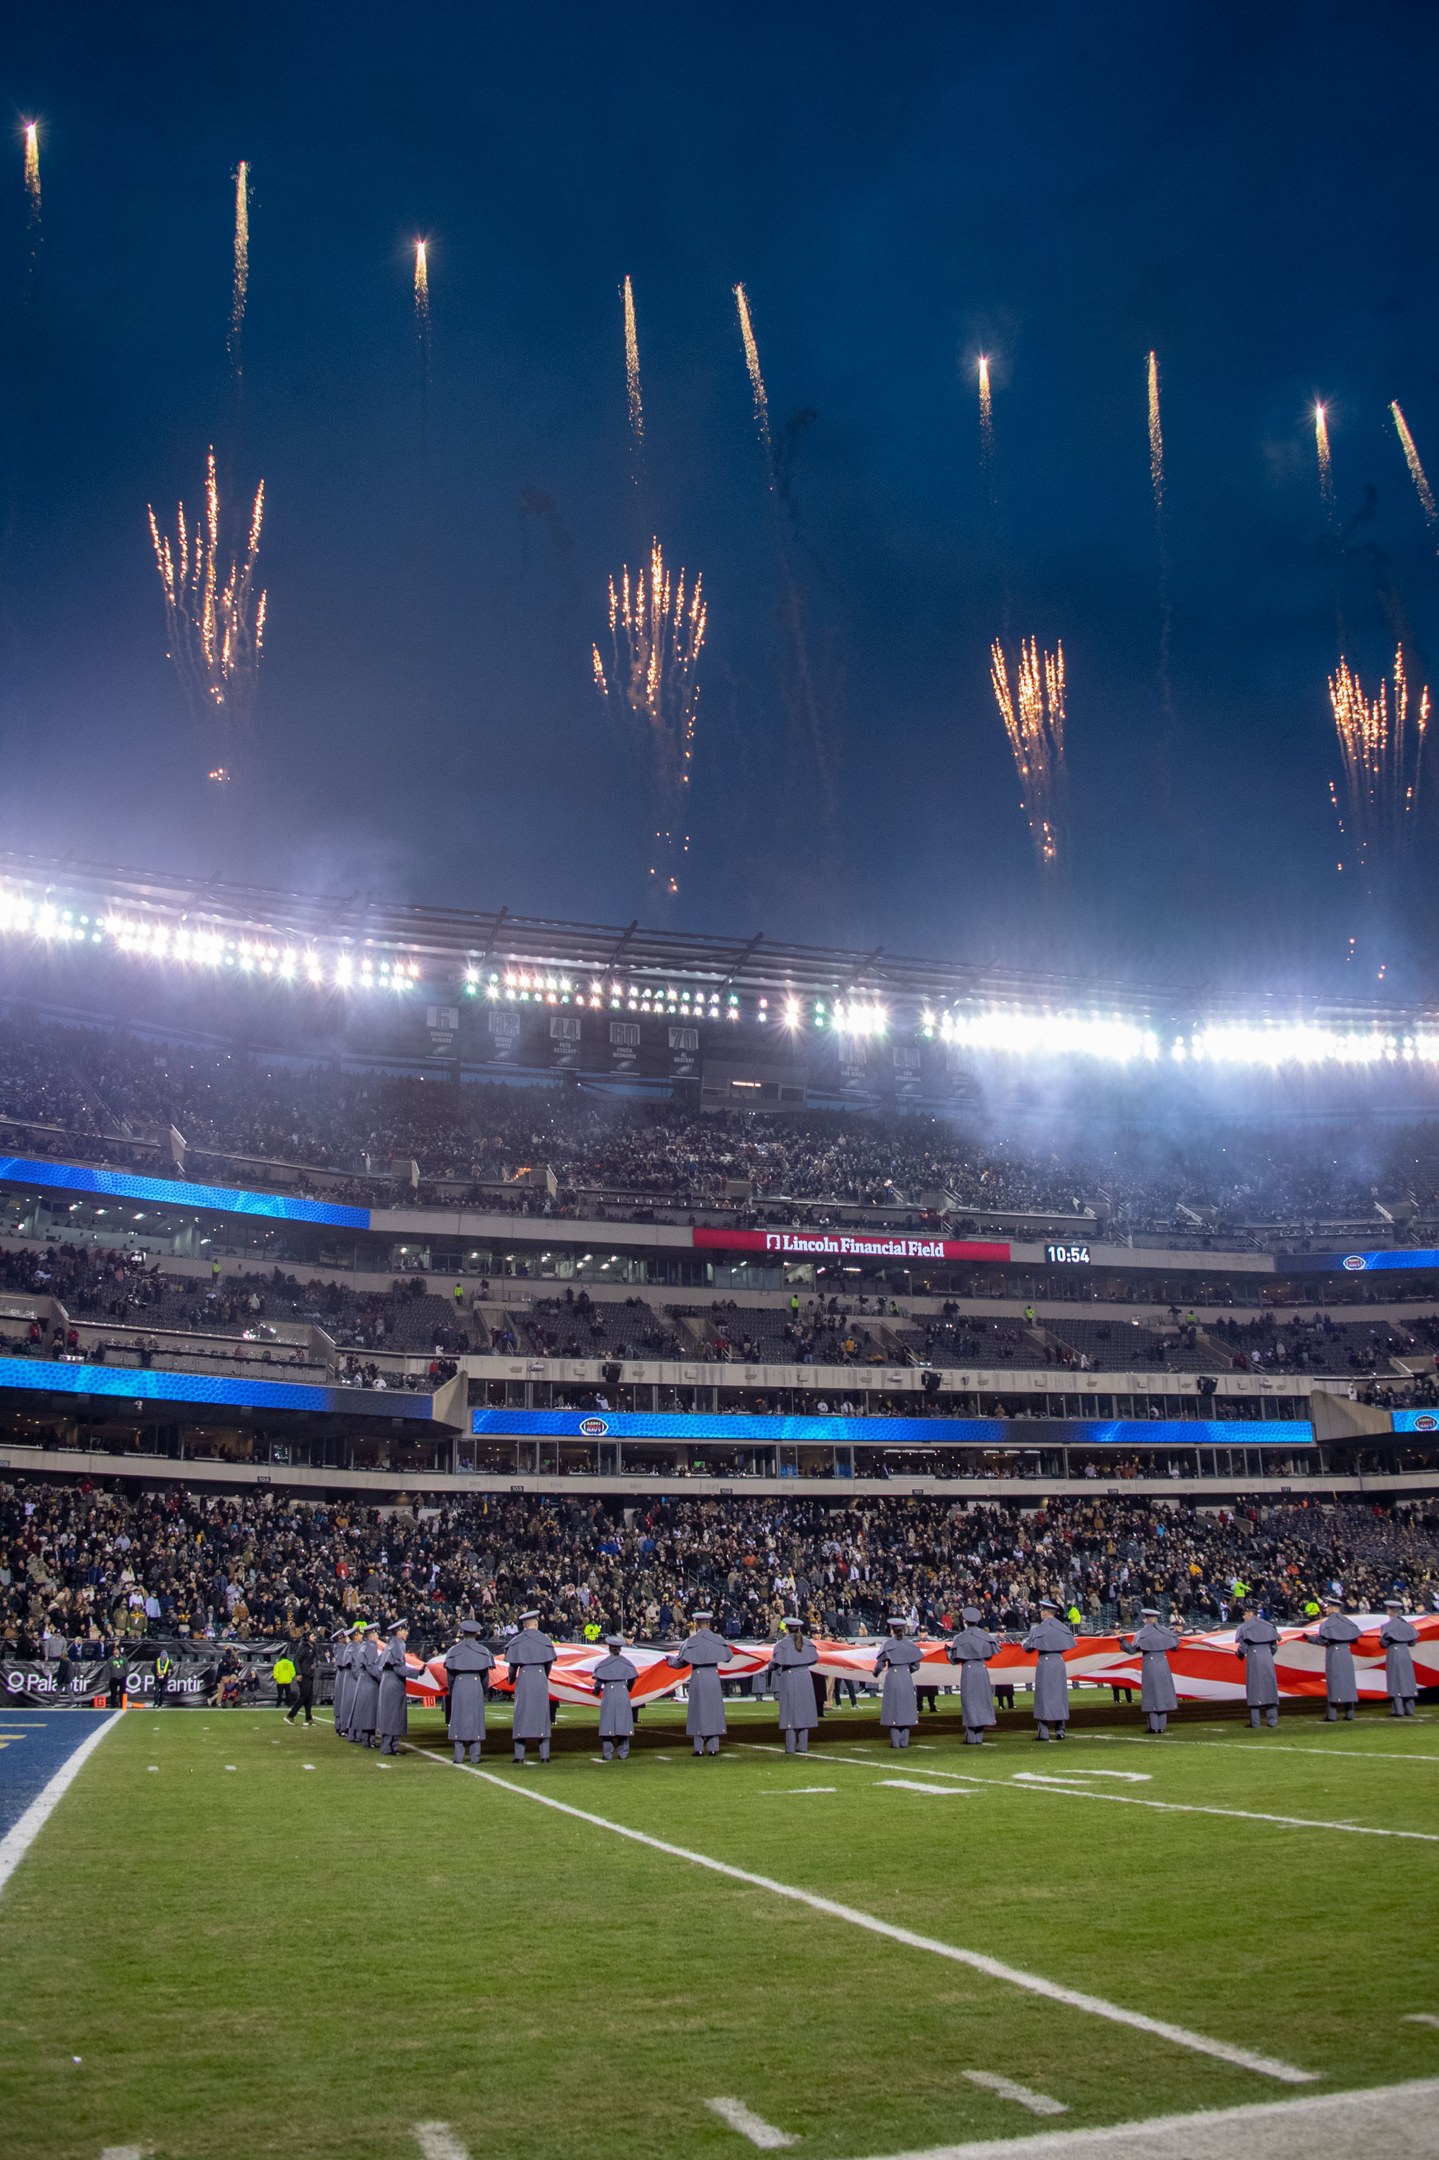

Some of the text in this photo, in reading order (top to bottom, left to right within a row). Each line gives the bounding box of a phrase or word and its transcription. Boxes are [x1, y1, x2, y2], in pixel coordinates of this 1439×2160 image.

[552, 1019, 577, 1041] 44
[612, 1024, 637, 1048] 60
[671, 1028, 696, 1051] 70
[782, 1235, 945, 1258] Lincoln Financial Field
[1048, 1246, 1090, 1263] 10:54
[27, 1673, 92, 1692] Palatir
[144, 1674, 204, 1692] Pantir
[426, 1696, 434, 1706] 10
